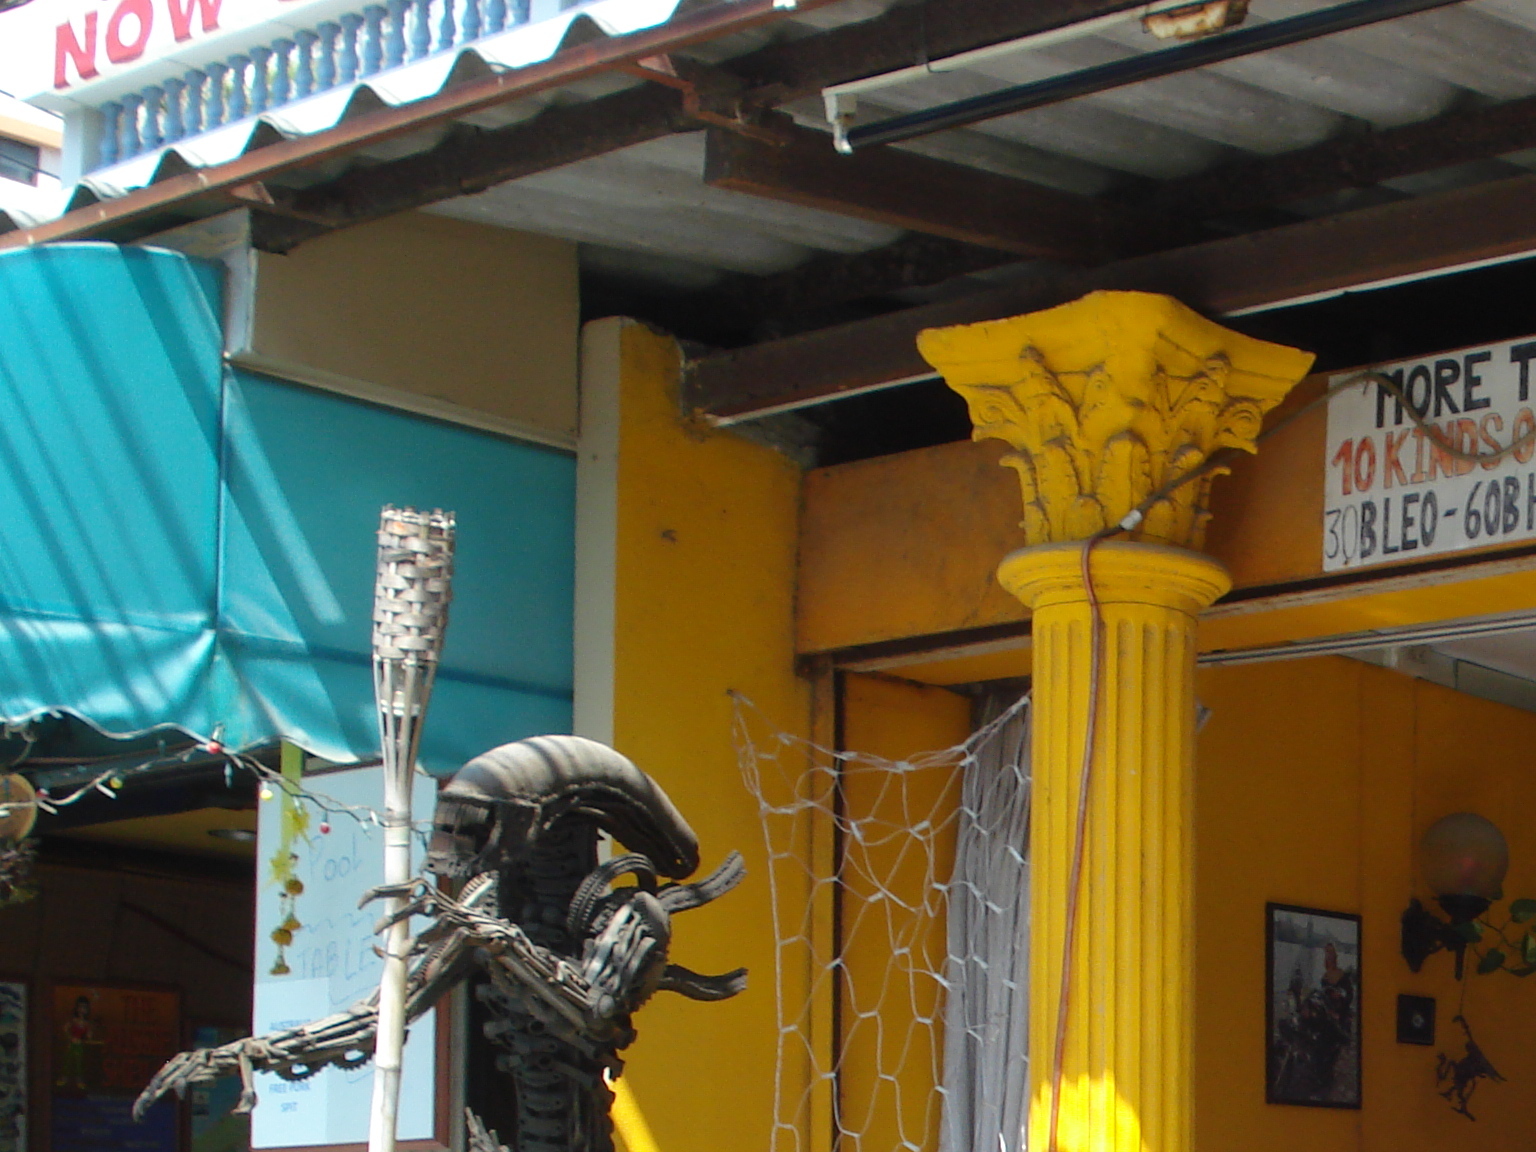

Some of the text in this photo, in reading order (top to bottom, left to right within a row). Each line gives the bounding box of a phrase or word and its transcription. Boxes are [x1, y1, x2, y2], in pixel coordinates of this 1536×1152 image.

[1375, 350, 1492, 428] MORE
[1332, 436, 1376, 495] 10
[1383, 411, 1503, 489] KINDS
[1464, 475, 1520, 541] 60B
